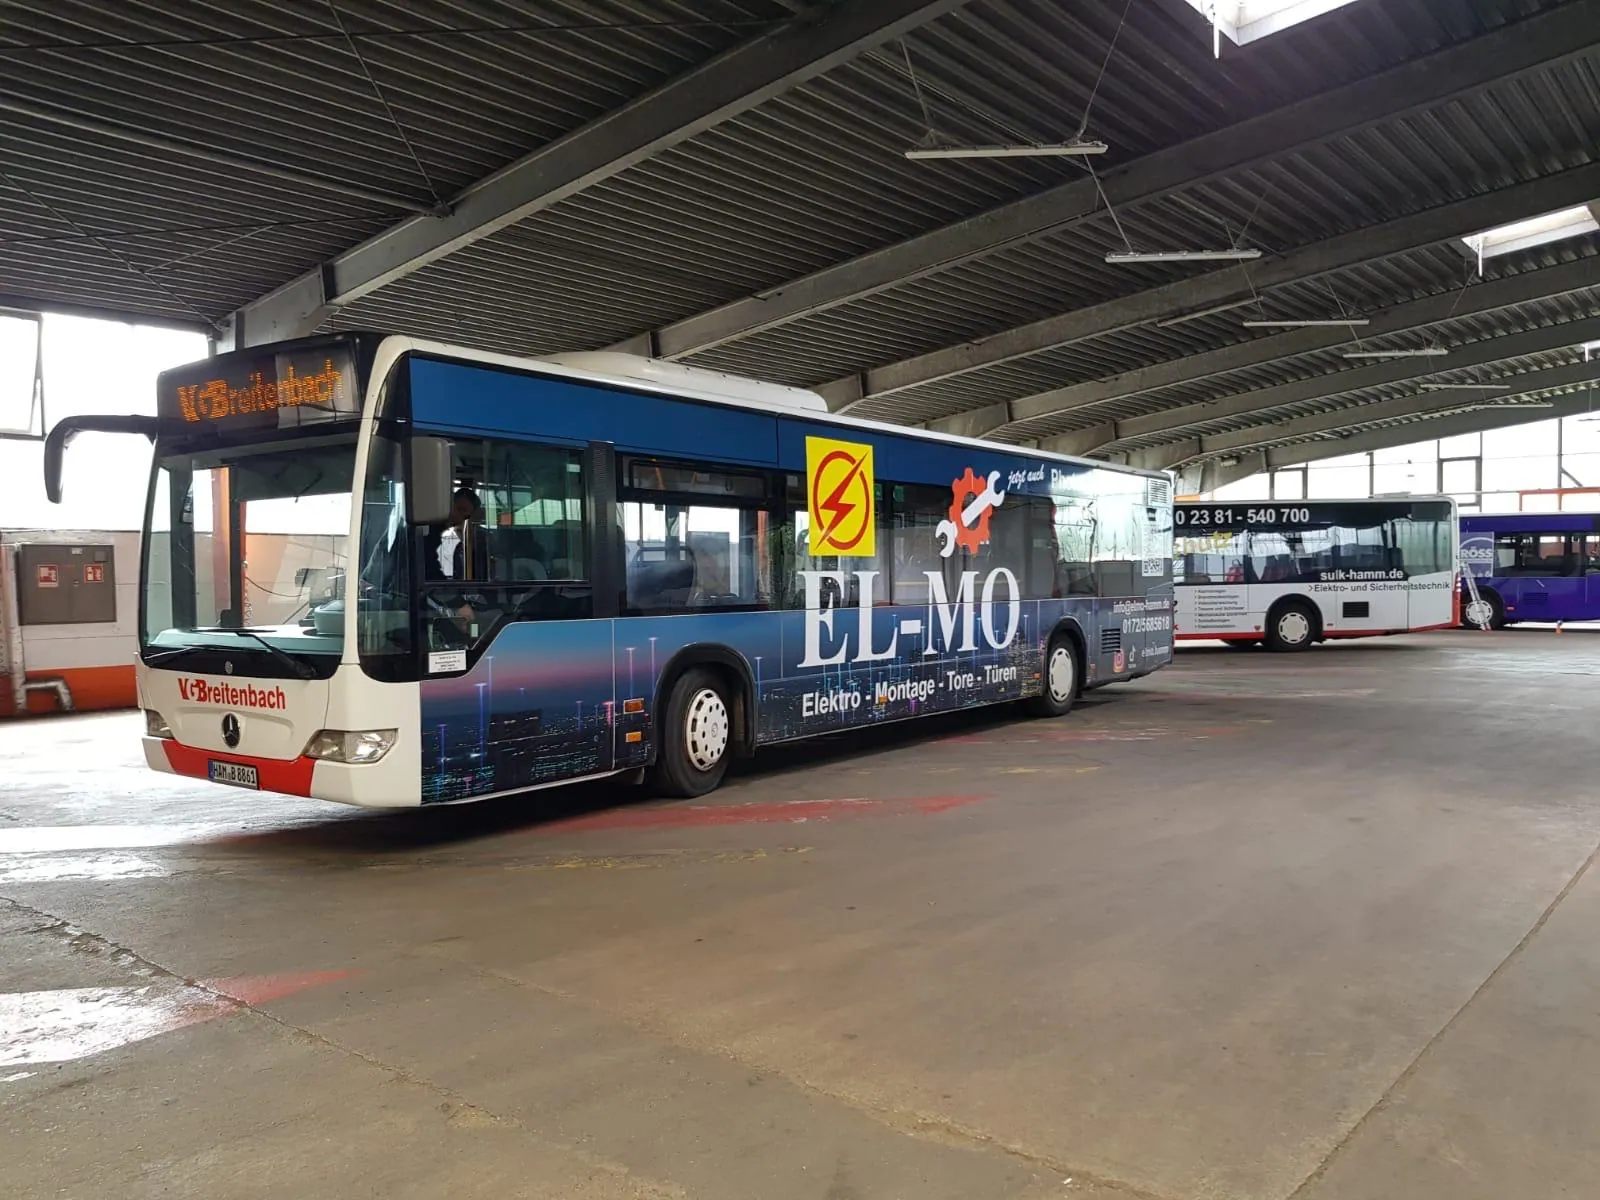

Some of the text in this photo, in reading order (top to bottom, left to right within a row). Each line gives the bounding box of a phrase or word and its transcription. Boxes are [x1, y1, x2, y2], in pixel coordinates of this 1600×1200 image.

[1026, 463, 1045, 481] auch
[1190, 510, 1210, 525] 23
[1214, 509, 1233, 524] 81
[1247, 509, 1276, 524] 540
[1280, 508, 1310, 523] 700
[1320, 568, 1404, 581] sulk-hamm.de
[1350, 583, 1368, 592] und
[1369, 582, 1450, 592] Sicherheitstechnik
[796, 567, 1020, 668] EL-MO
[802, 690, 861, 717] Elektro
[875, 678, 935, 704] Montage
[946, 671, 974, 691] Tore
[984, 665, 1017, 685] Türen
[213, 762, 256, 784] HAM B 8861
